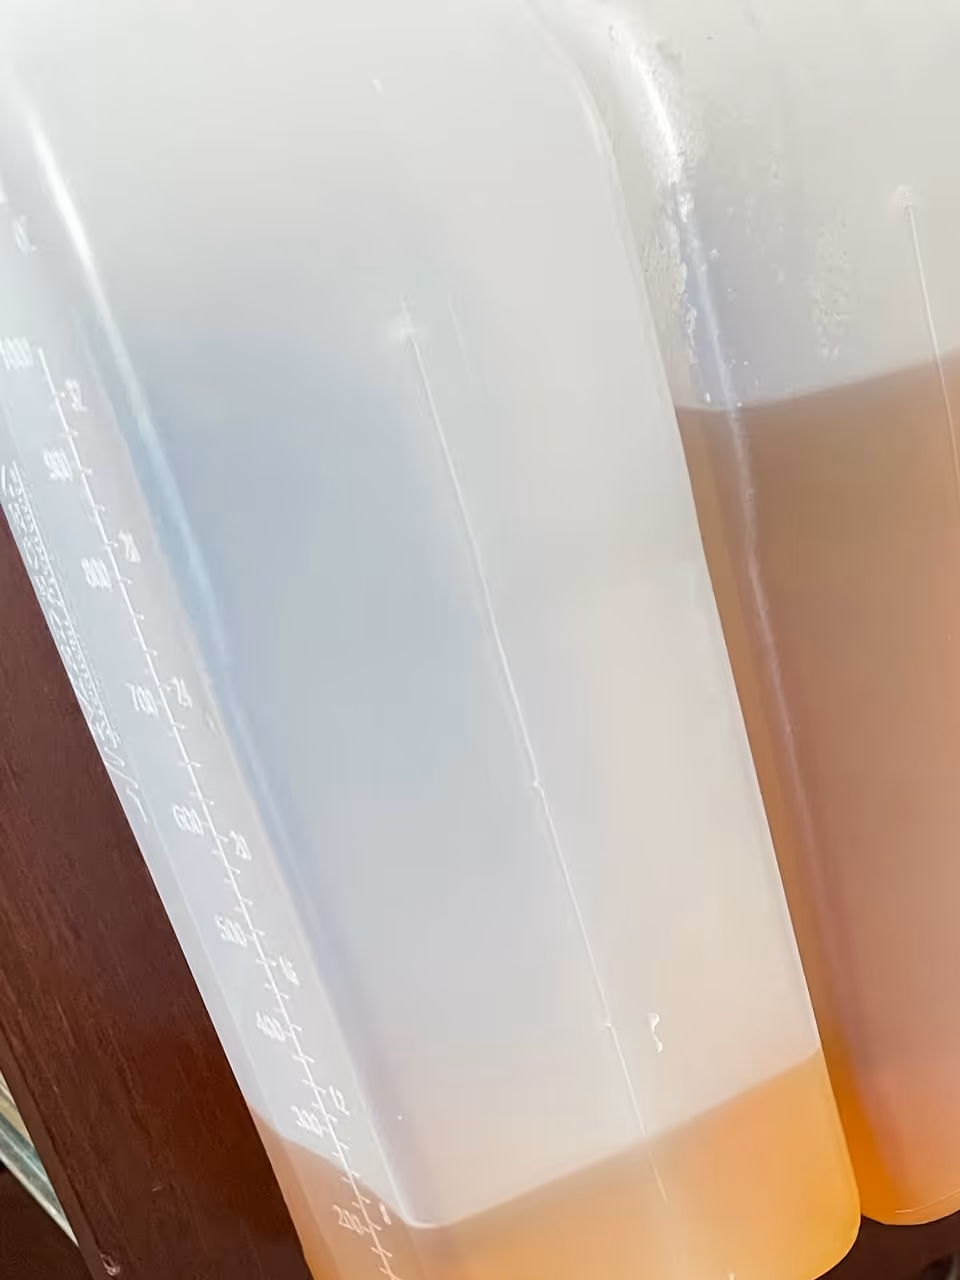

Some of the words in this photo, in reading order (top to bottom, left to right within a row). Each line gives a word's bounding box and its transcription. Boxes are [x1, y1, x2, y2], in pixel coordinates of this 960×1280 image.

[124, 682, 160, 720] 700
[172, 803, 205, 836] 600
[214, 914, 248, 949] 500
[254, 1010, 286, 1043] 400
[328, 1084, 352, 1117] 12
[288, 1104, 324, 1138] 300
[331, 1203, 365, 1236] 200
